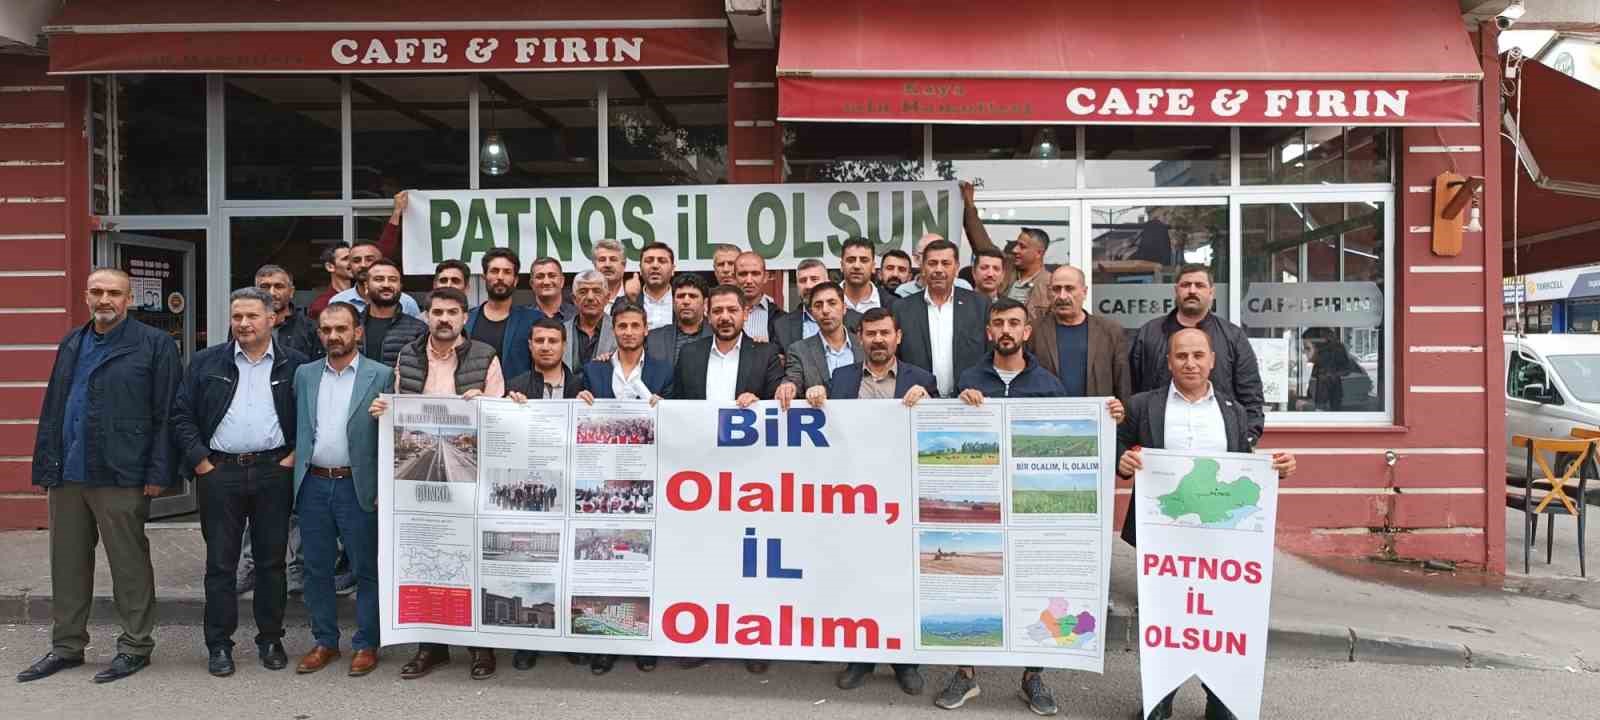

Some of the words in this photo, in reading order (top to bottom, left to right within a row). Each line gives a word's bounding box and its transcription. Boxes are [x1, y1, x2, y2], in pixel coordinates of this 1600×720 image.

[331, 38, 448, 65] CAFE
[465, 38, 499, 64] &
[514, 37, 644, 63] FIRIN
[1065, 87, 1196, 116] CAFE
[1210, 89, 1249, 118] &
[1264, 89, 1410, 118] FIRIN
[429, 193, 655, 263] PATNOS
[746, 189, 951, 261] OLSUN
[665, 470, 900, 525] Olalım,
[1143, 554, 1262, 584] PATNOS
[661, 601, 901, 650] Olalım.
[1145, 625, 1247, 656] OLSUN
